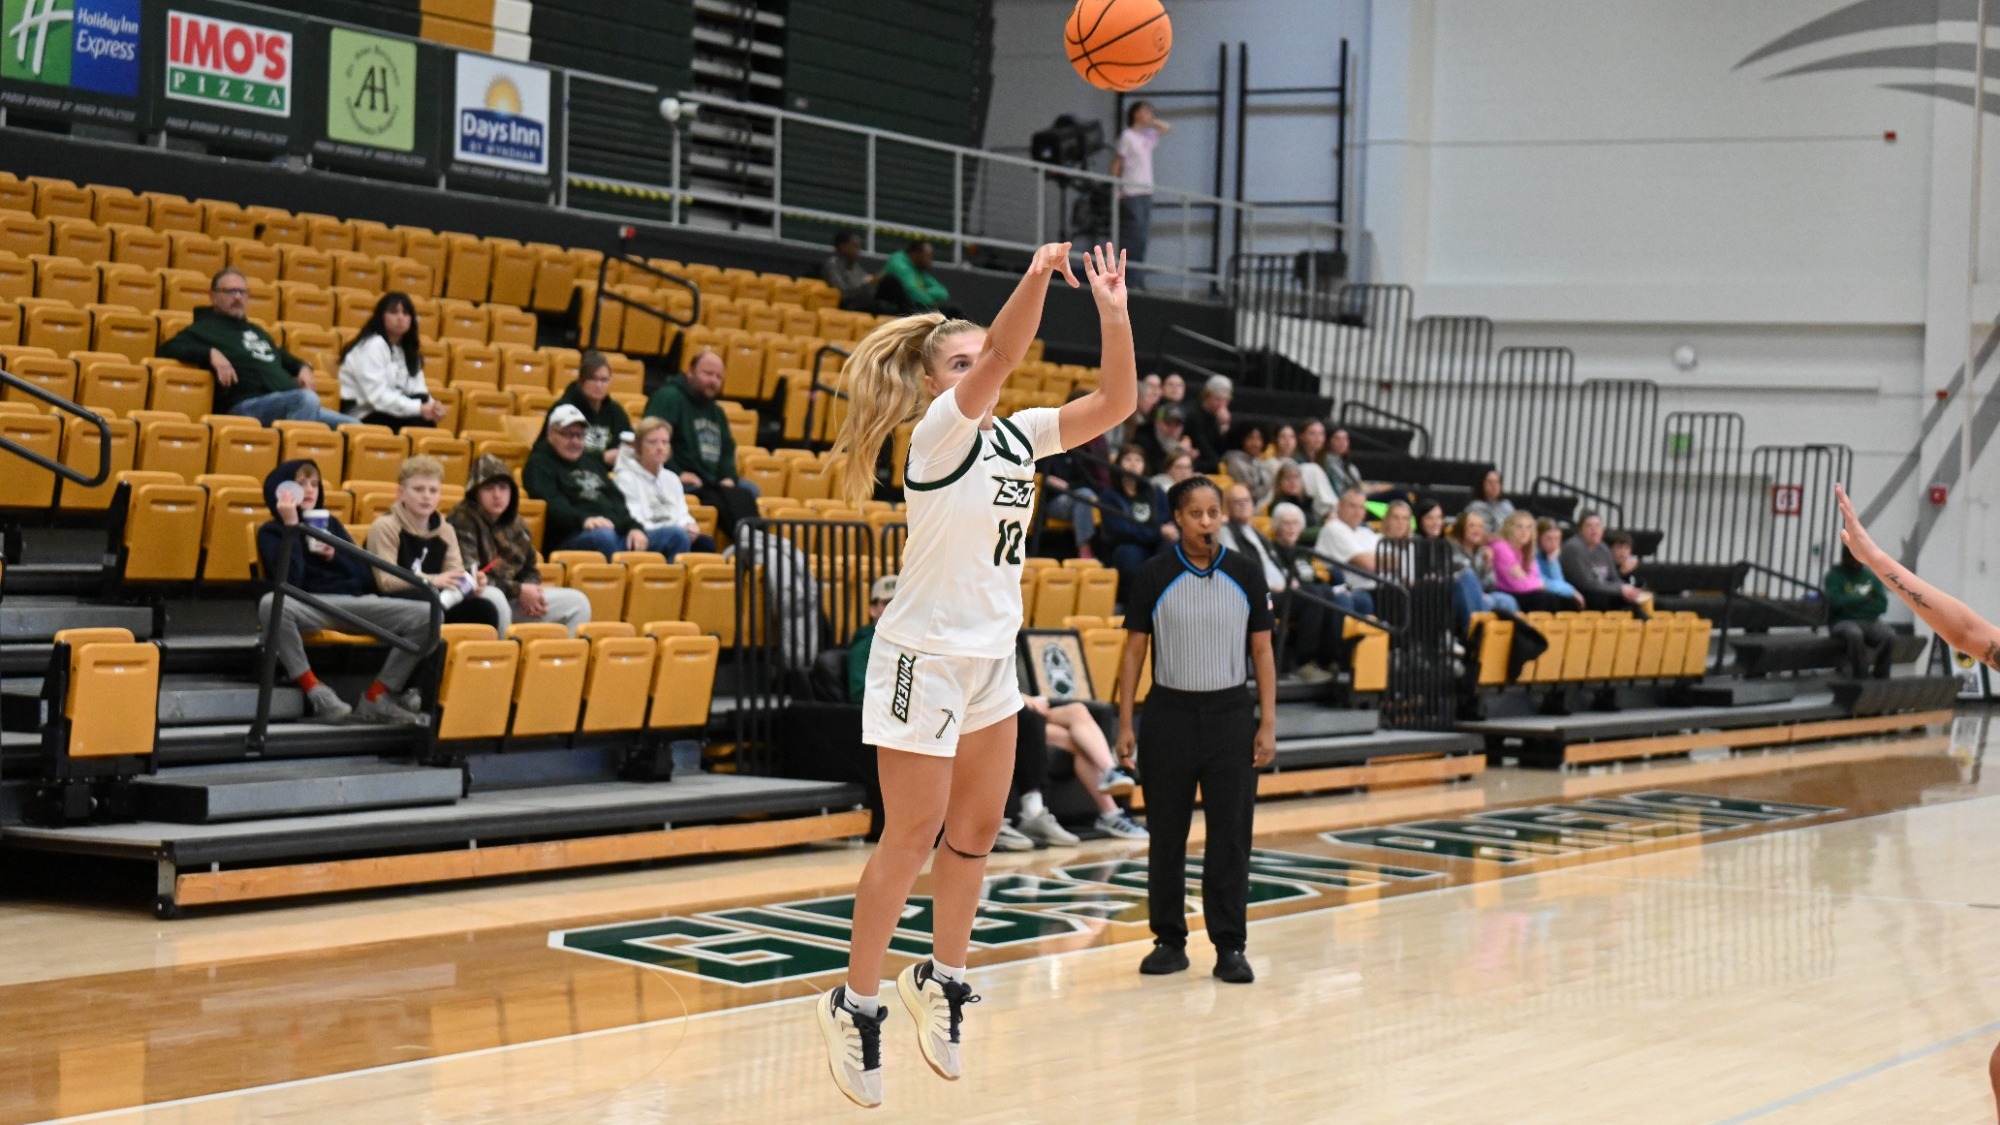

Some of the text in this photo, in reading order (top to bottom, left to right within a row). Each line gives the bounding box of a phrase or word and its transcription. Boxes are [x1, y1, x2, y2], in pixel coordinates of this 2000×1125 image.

[78, 7, 139, 35] Holiday Inn
[76, 29, 136, 60] Express
[169, 16, 287, 82] IMO'S
[463, 112, 540, 147] Days Inn
[892, 654, 914, 723] MINERS
